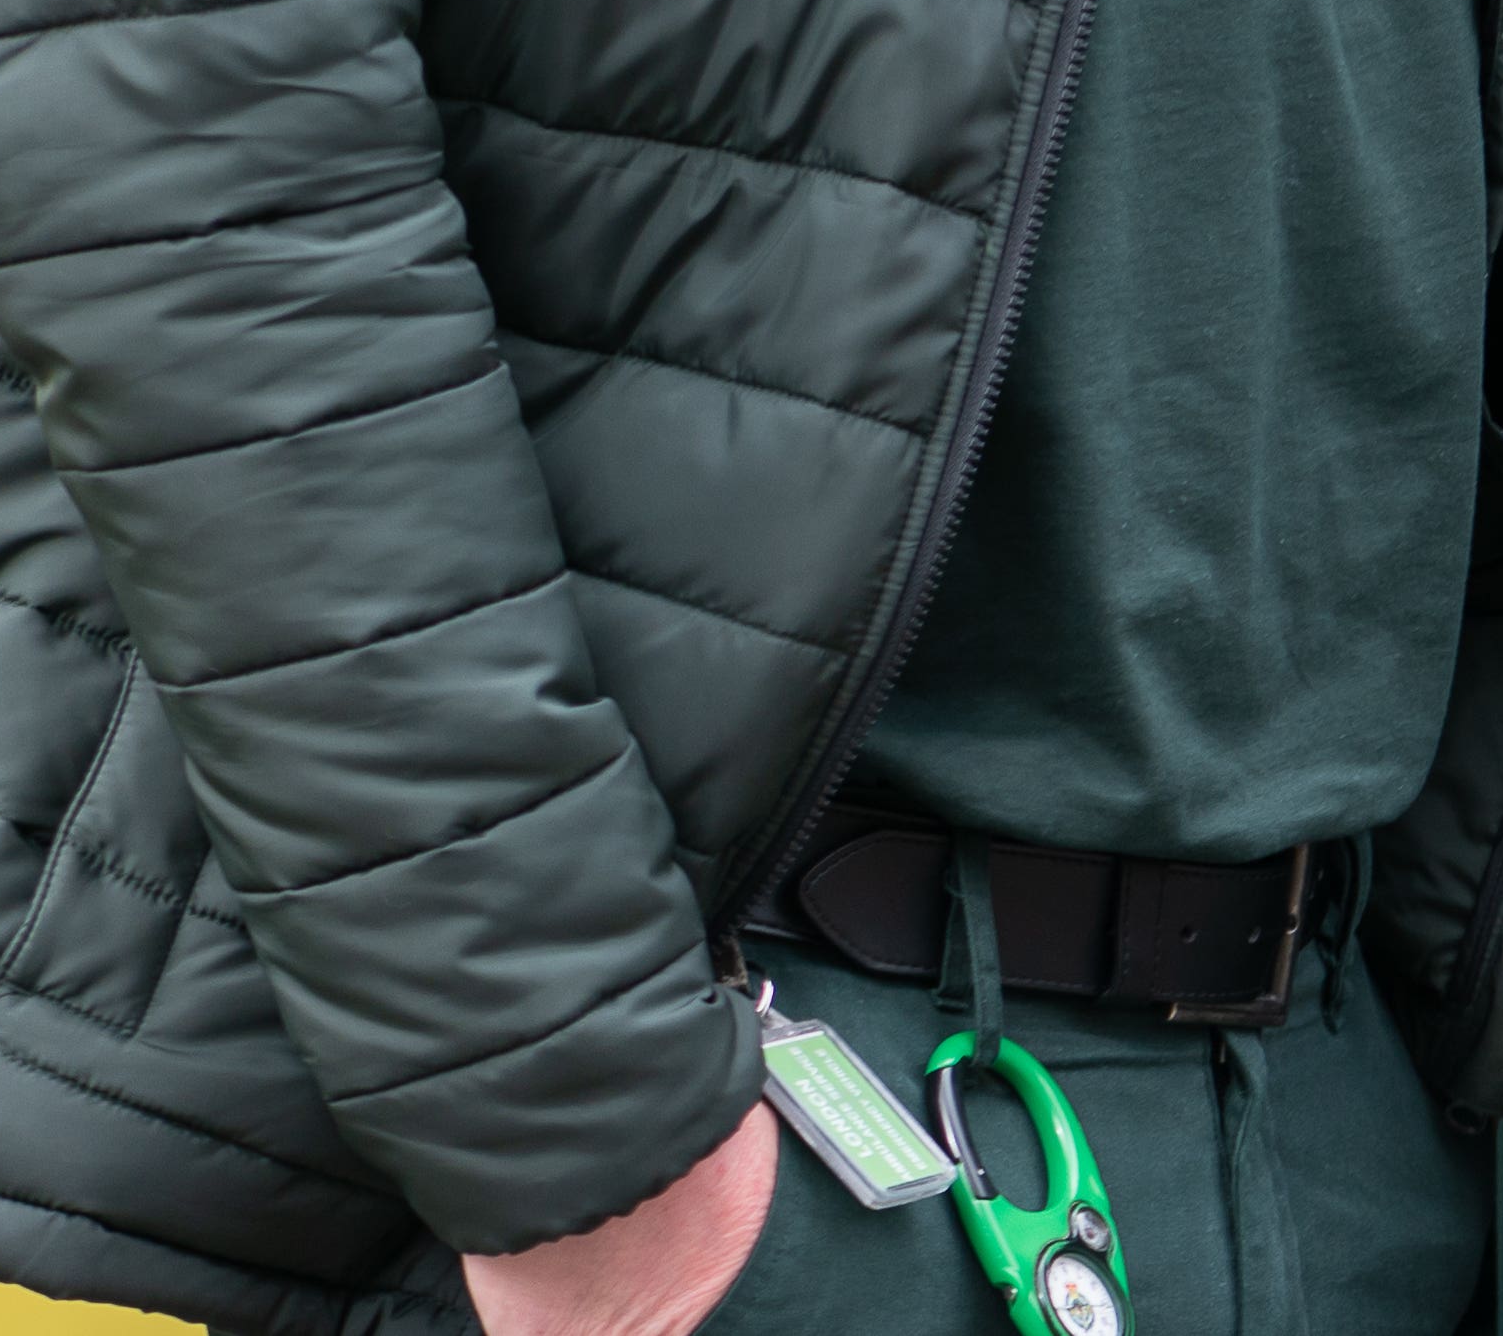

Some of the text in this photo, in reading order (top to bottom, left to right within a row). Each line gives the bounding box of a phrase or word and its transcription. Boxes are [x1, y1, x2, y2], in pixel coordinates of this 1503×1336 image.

[787, 1046, 914, 1180] AMBULANCE SERVICE
[794, 1079, 874, 1158] LONDON
[813, 1048, 928, 1171] EMERGENCY VEHICLE
